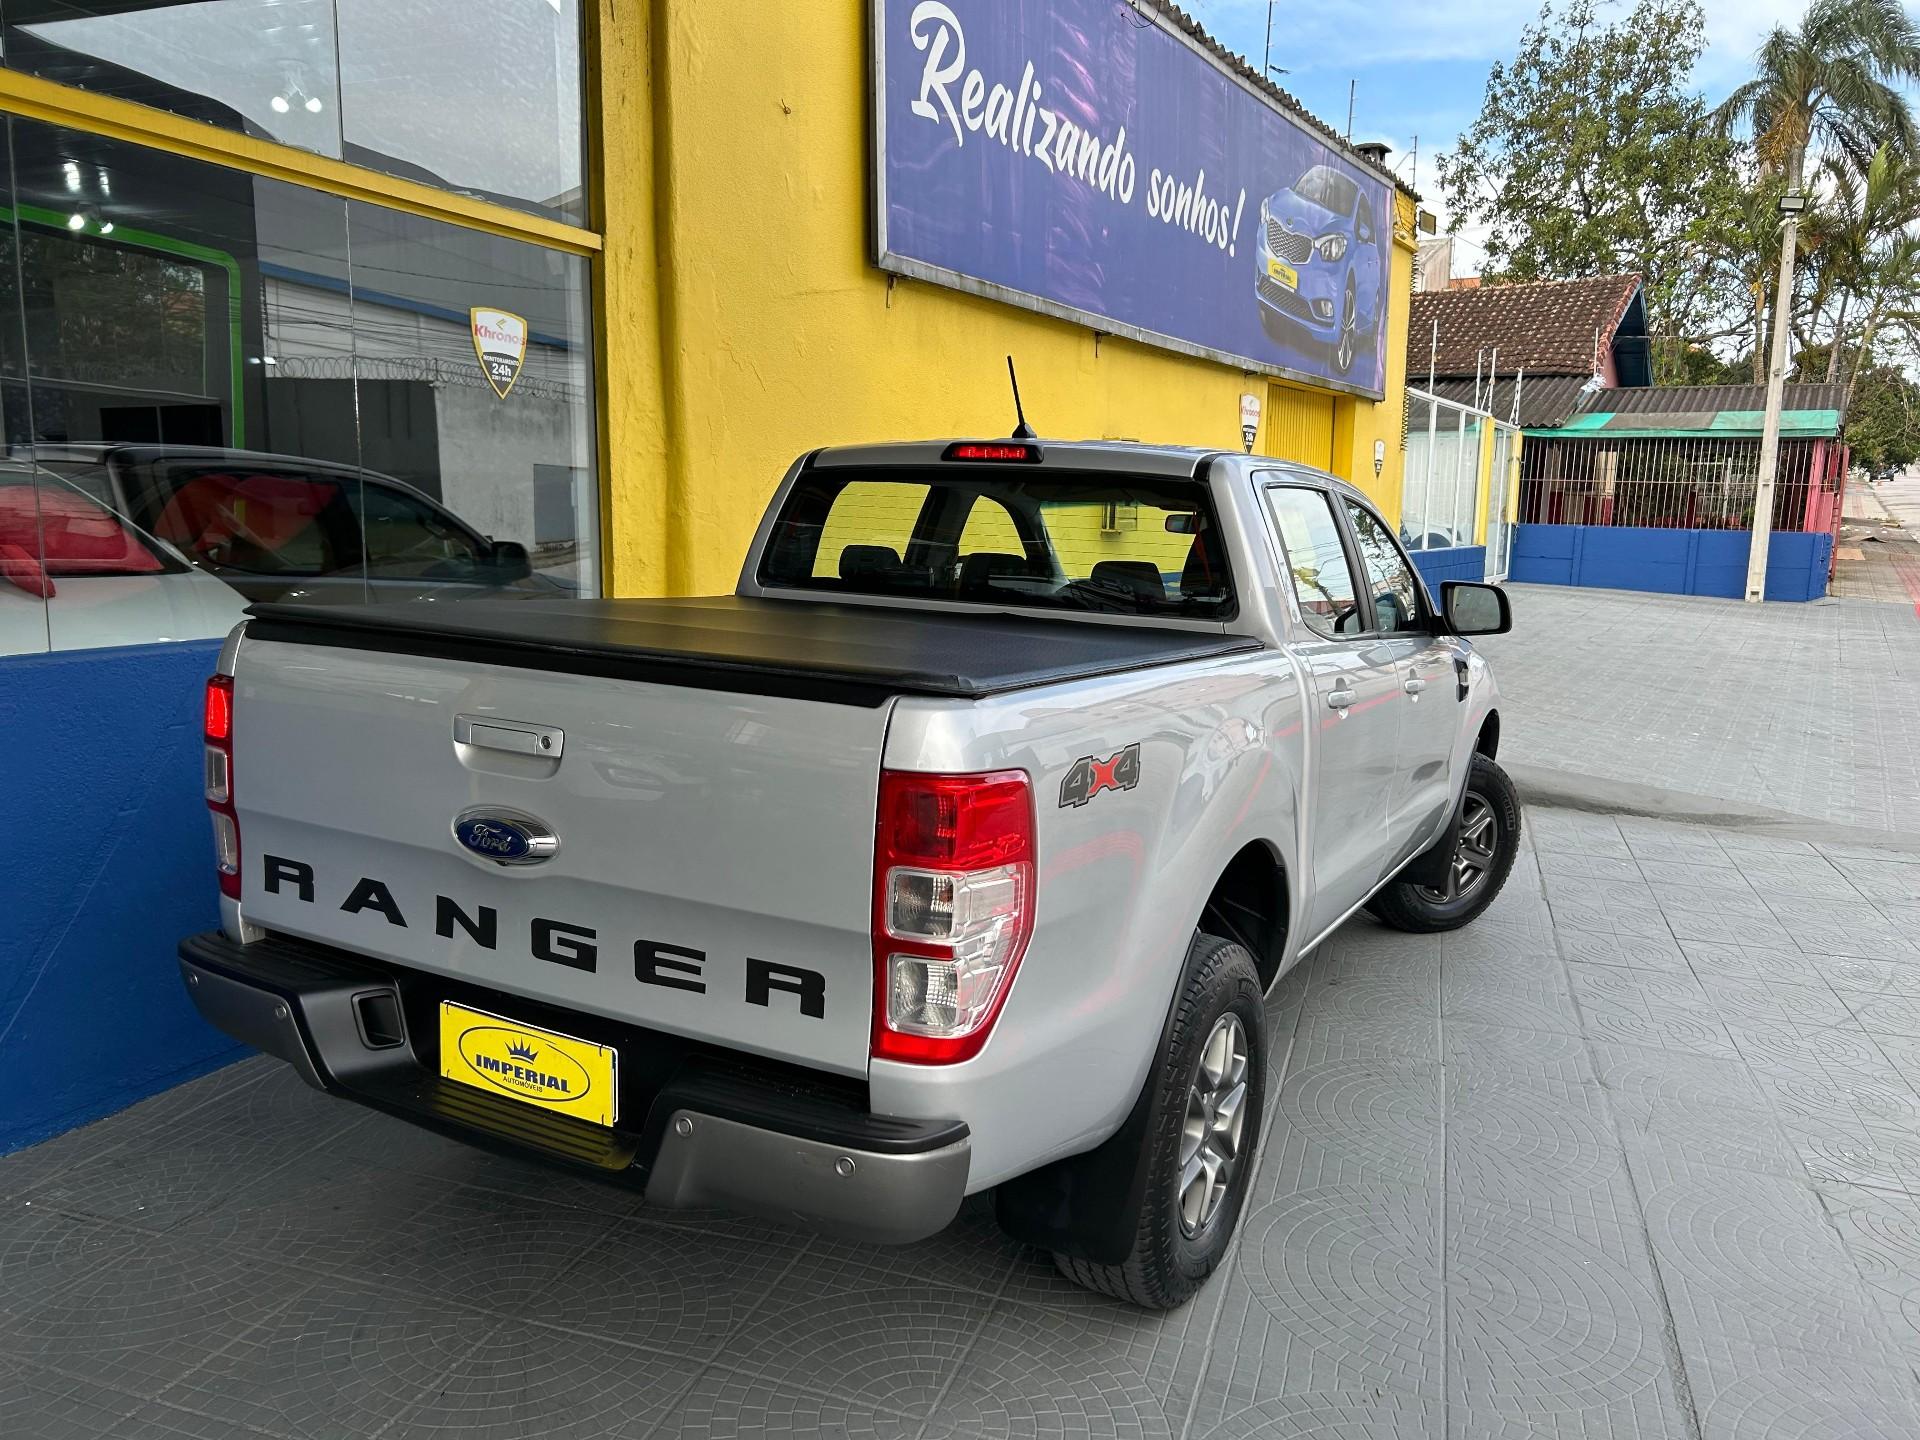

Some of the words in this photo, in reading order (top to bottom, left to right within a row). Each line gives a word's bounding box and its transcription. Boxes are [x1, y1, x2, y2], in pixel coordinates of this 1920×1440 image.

[911, 0, 1136, 204] Realizando
[1147, 168, 1246, 257] sonhos!
[474, 324, 526, 346] Khronos
[492, 362, 512, 377] 24h
[469, 824, 511, 853] Ford
[264, 854, 826, 1019] RANGER
[475, 1053, 572, 1094] IMPERIAL
[502, 1076, 544, 1093] AUTOMÓVEIS
